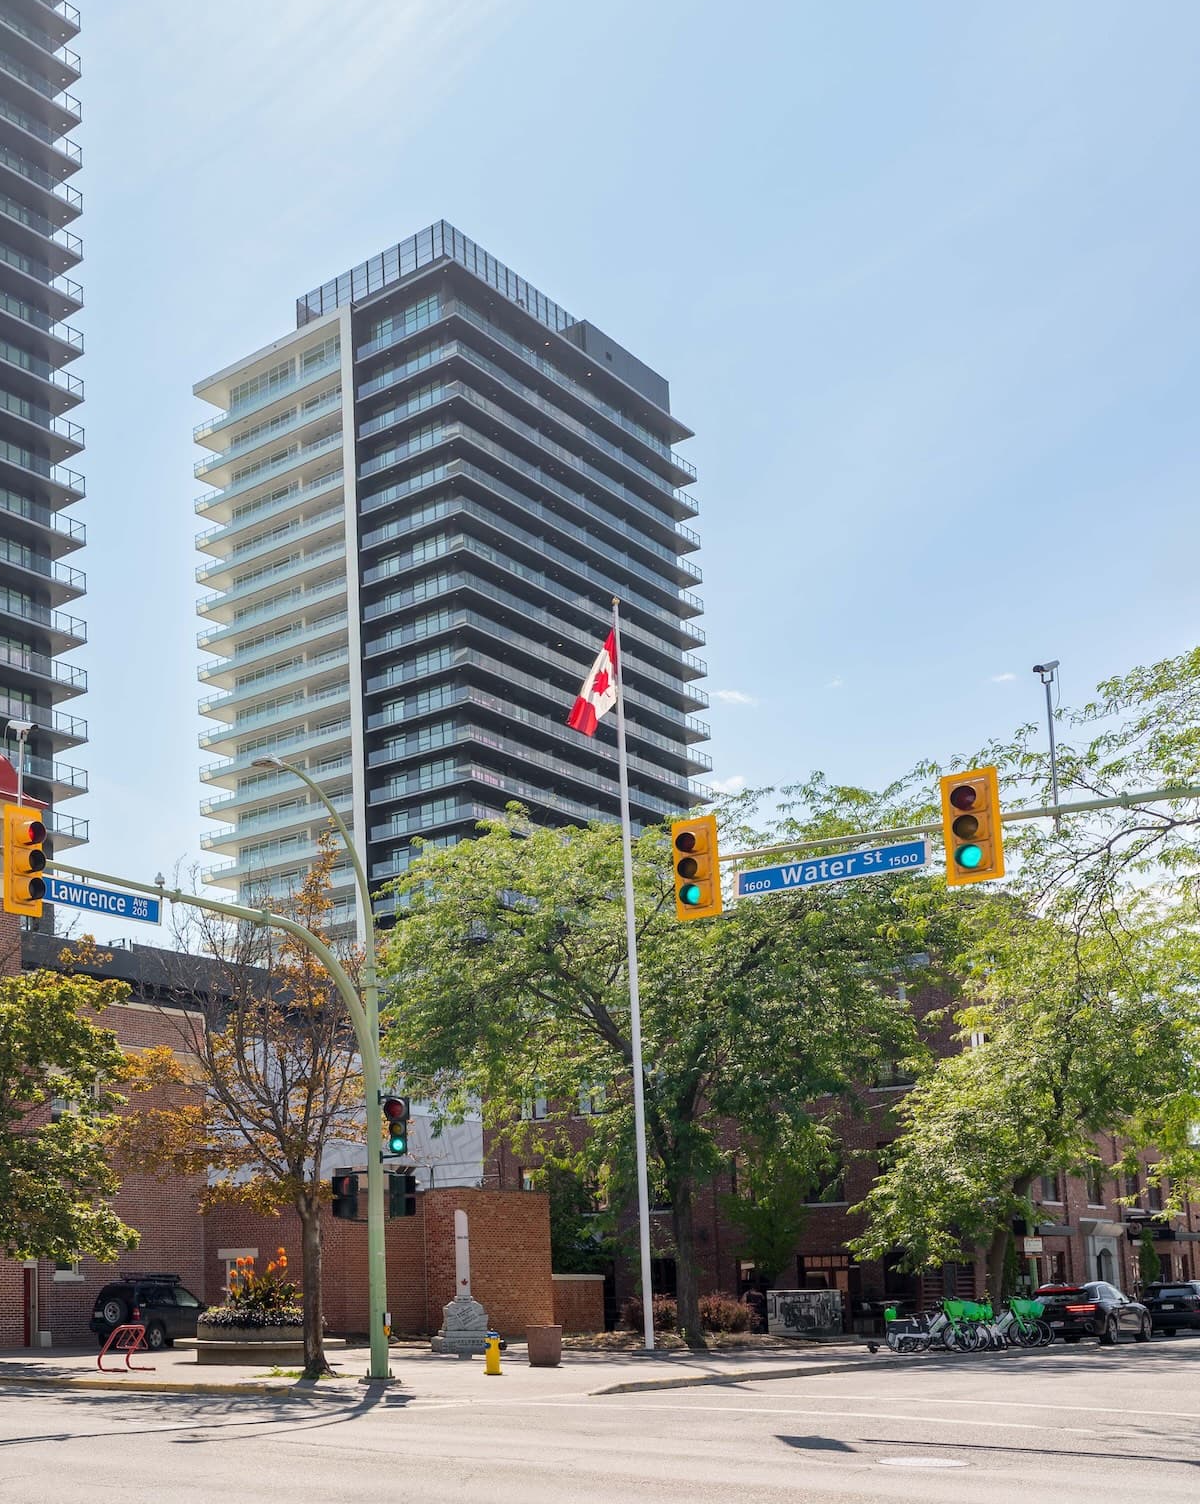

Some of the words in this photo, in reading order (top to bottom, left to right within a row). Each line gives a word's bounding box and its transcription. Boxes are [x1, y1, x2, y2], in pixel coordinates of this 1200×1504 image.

[744, 879, 771, 892] 1600
[781, 858, 856, 884] Water
[863, 851, 883, 865] St
[888, 853, 918, 867] 1500
[51, 880, 126, 912] Lawrence
[133, 898, 148, 907] Ave
[132, 906, 148, 917] 200
